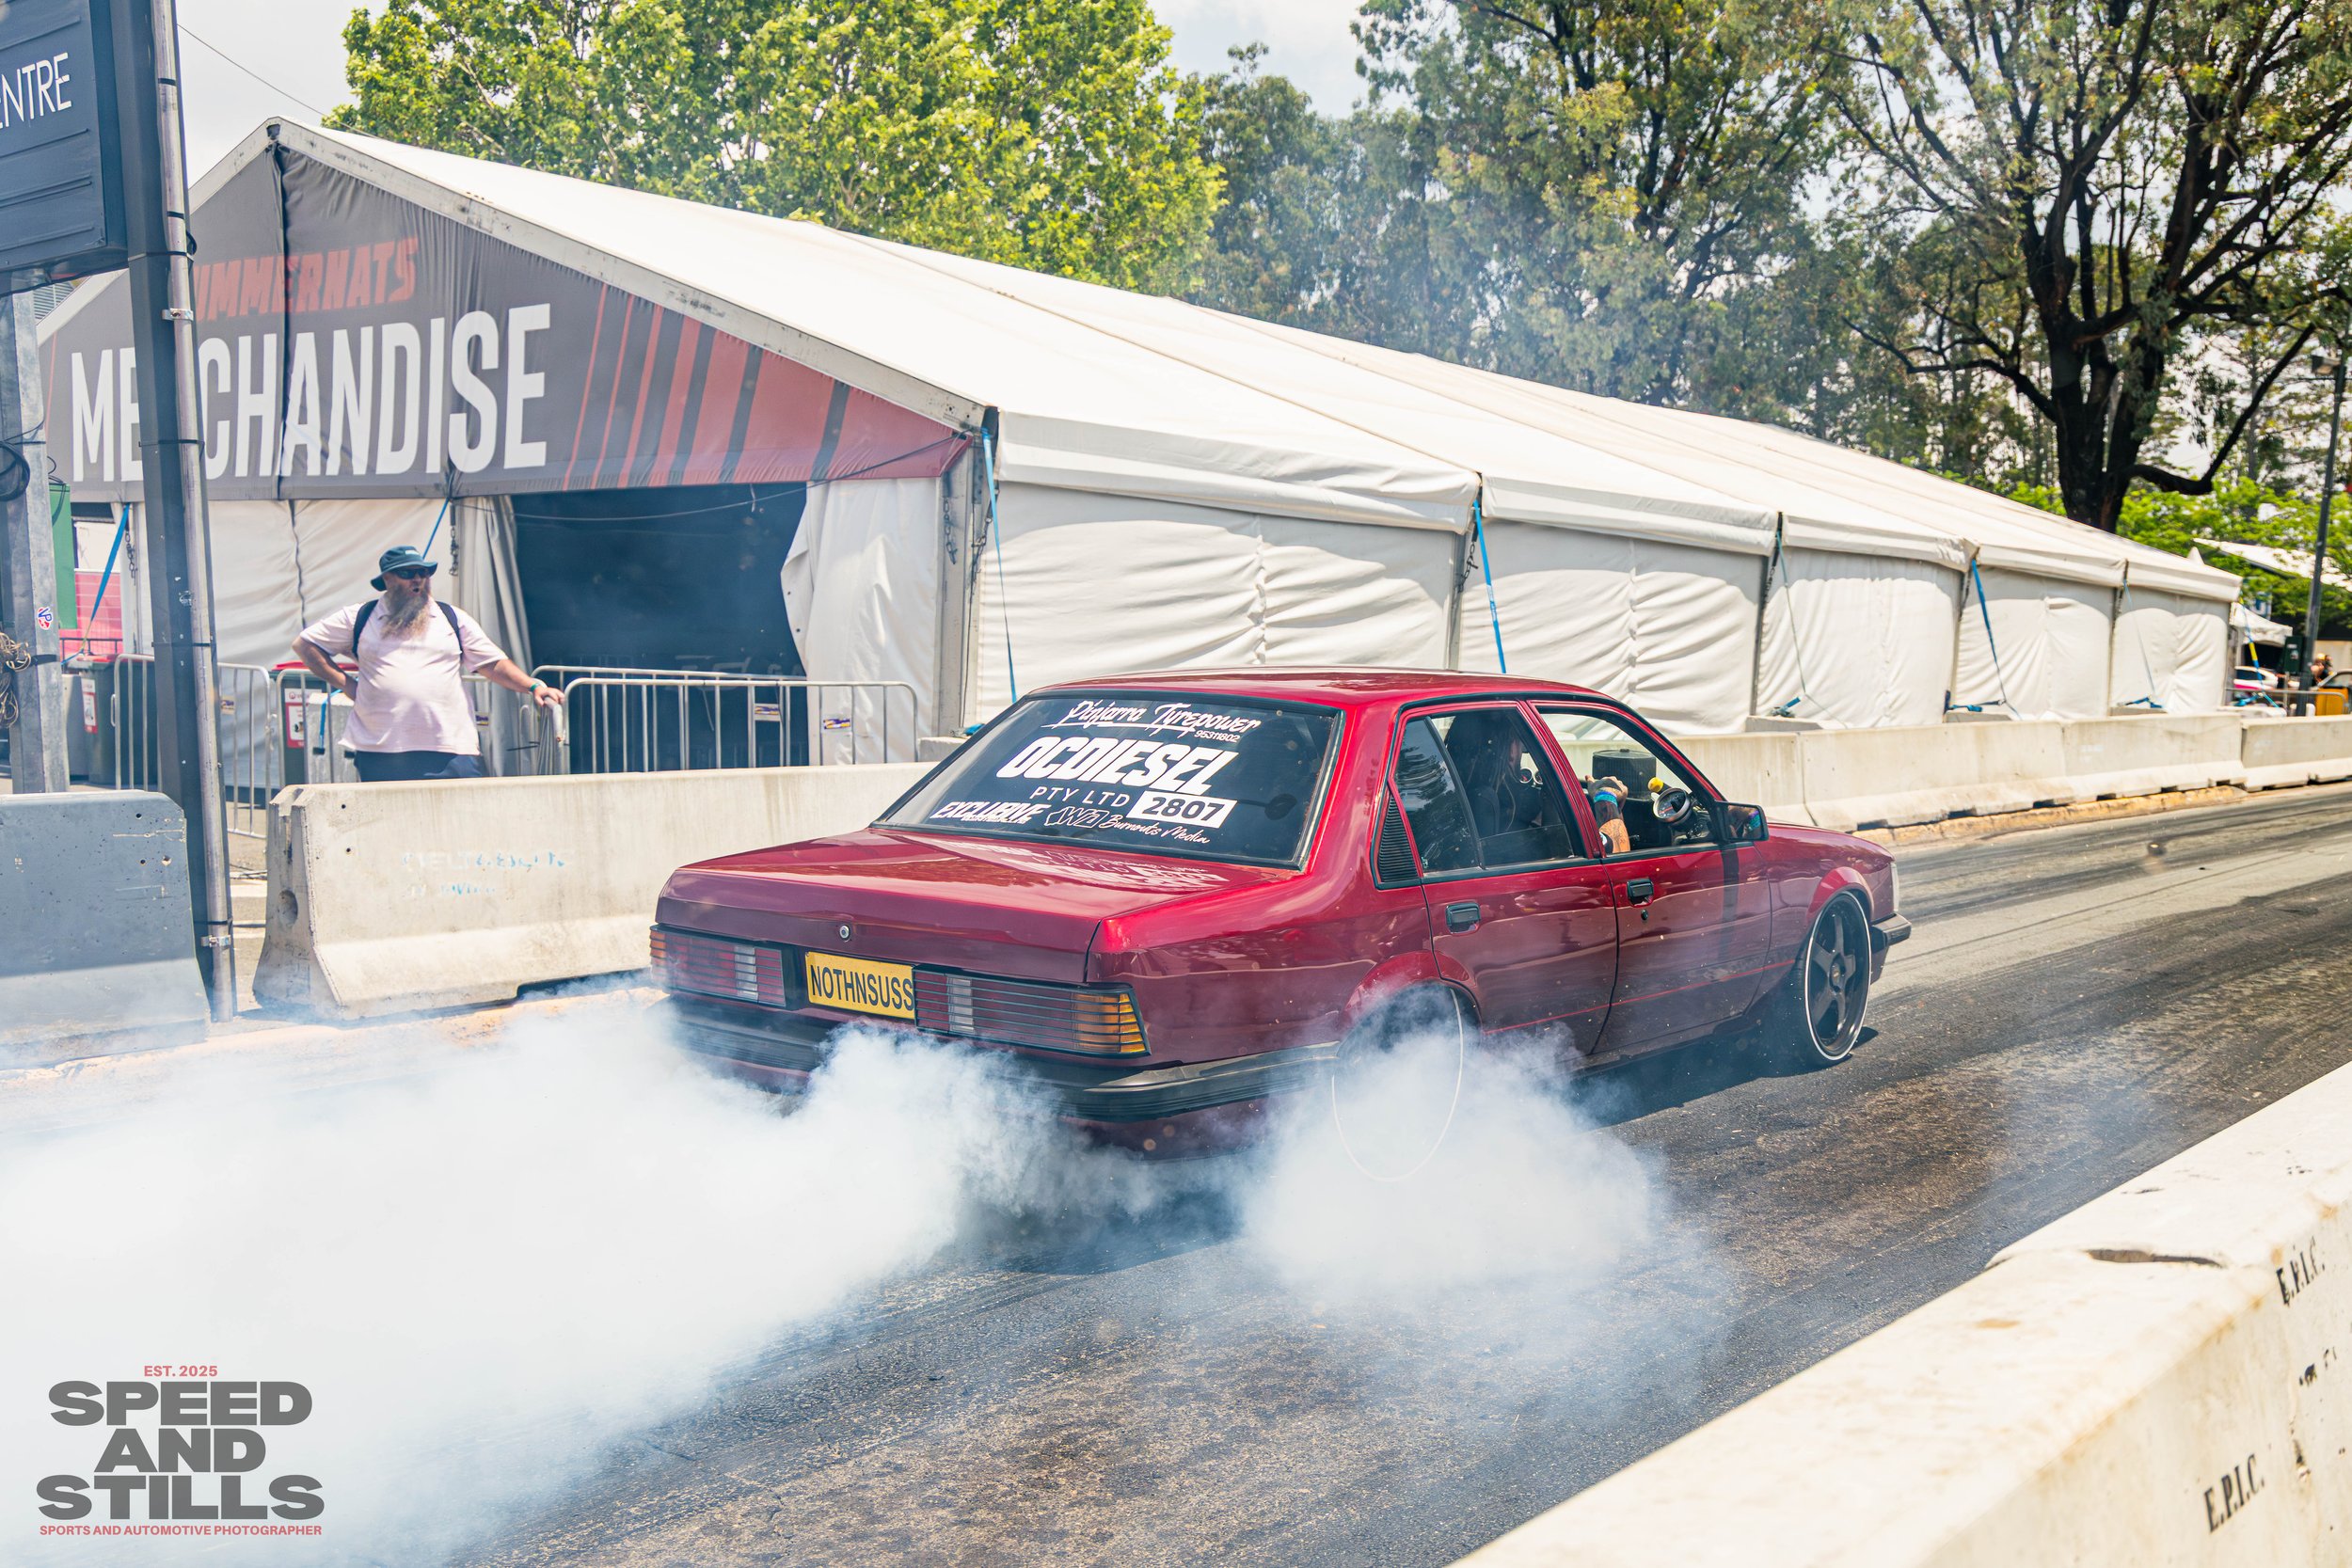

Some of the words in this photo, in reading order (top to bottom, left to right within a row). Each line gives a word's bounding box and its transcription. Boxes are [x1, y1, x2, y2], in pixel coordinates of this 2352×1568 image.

[0, 52, 72, 128] NTRE
[193, 236, 419, 324] UMMERNATS
[72, 303, 551, 483] MECHANDISE
[1194, 730, 1240, 743] 95311802
[995, 736, 1239, 796] OCDIESEL
[1029, 786, 1079, 801] PTY
[1082, 790, 1130, 807] LTD
[1142, 796, 1225, 822] 2807
[1099, 814, 1163, 836] Burnouts
[1161, 825, 1210, 844] Media
[810, 964, 914, 1011] NOTHNSUSS
[2203, 1453, 2265, 1533] E.P.I.C.
